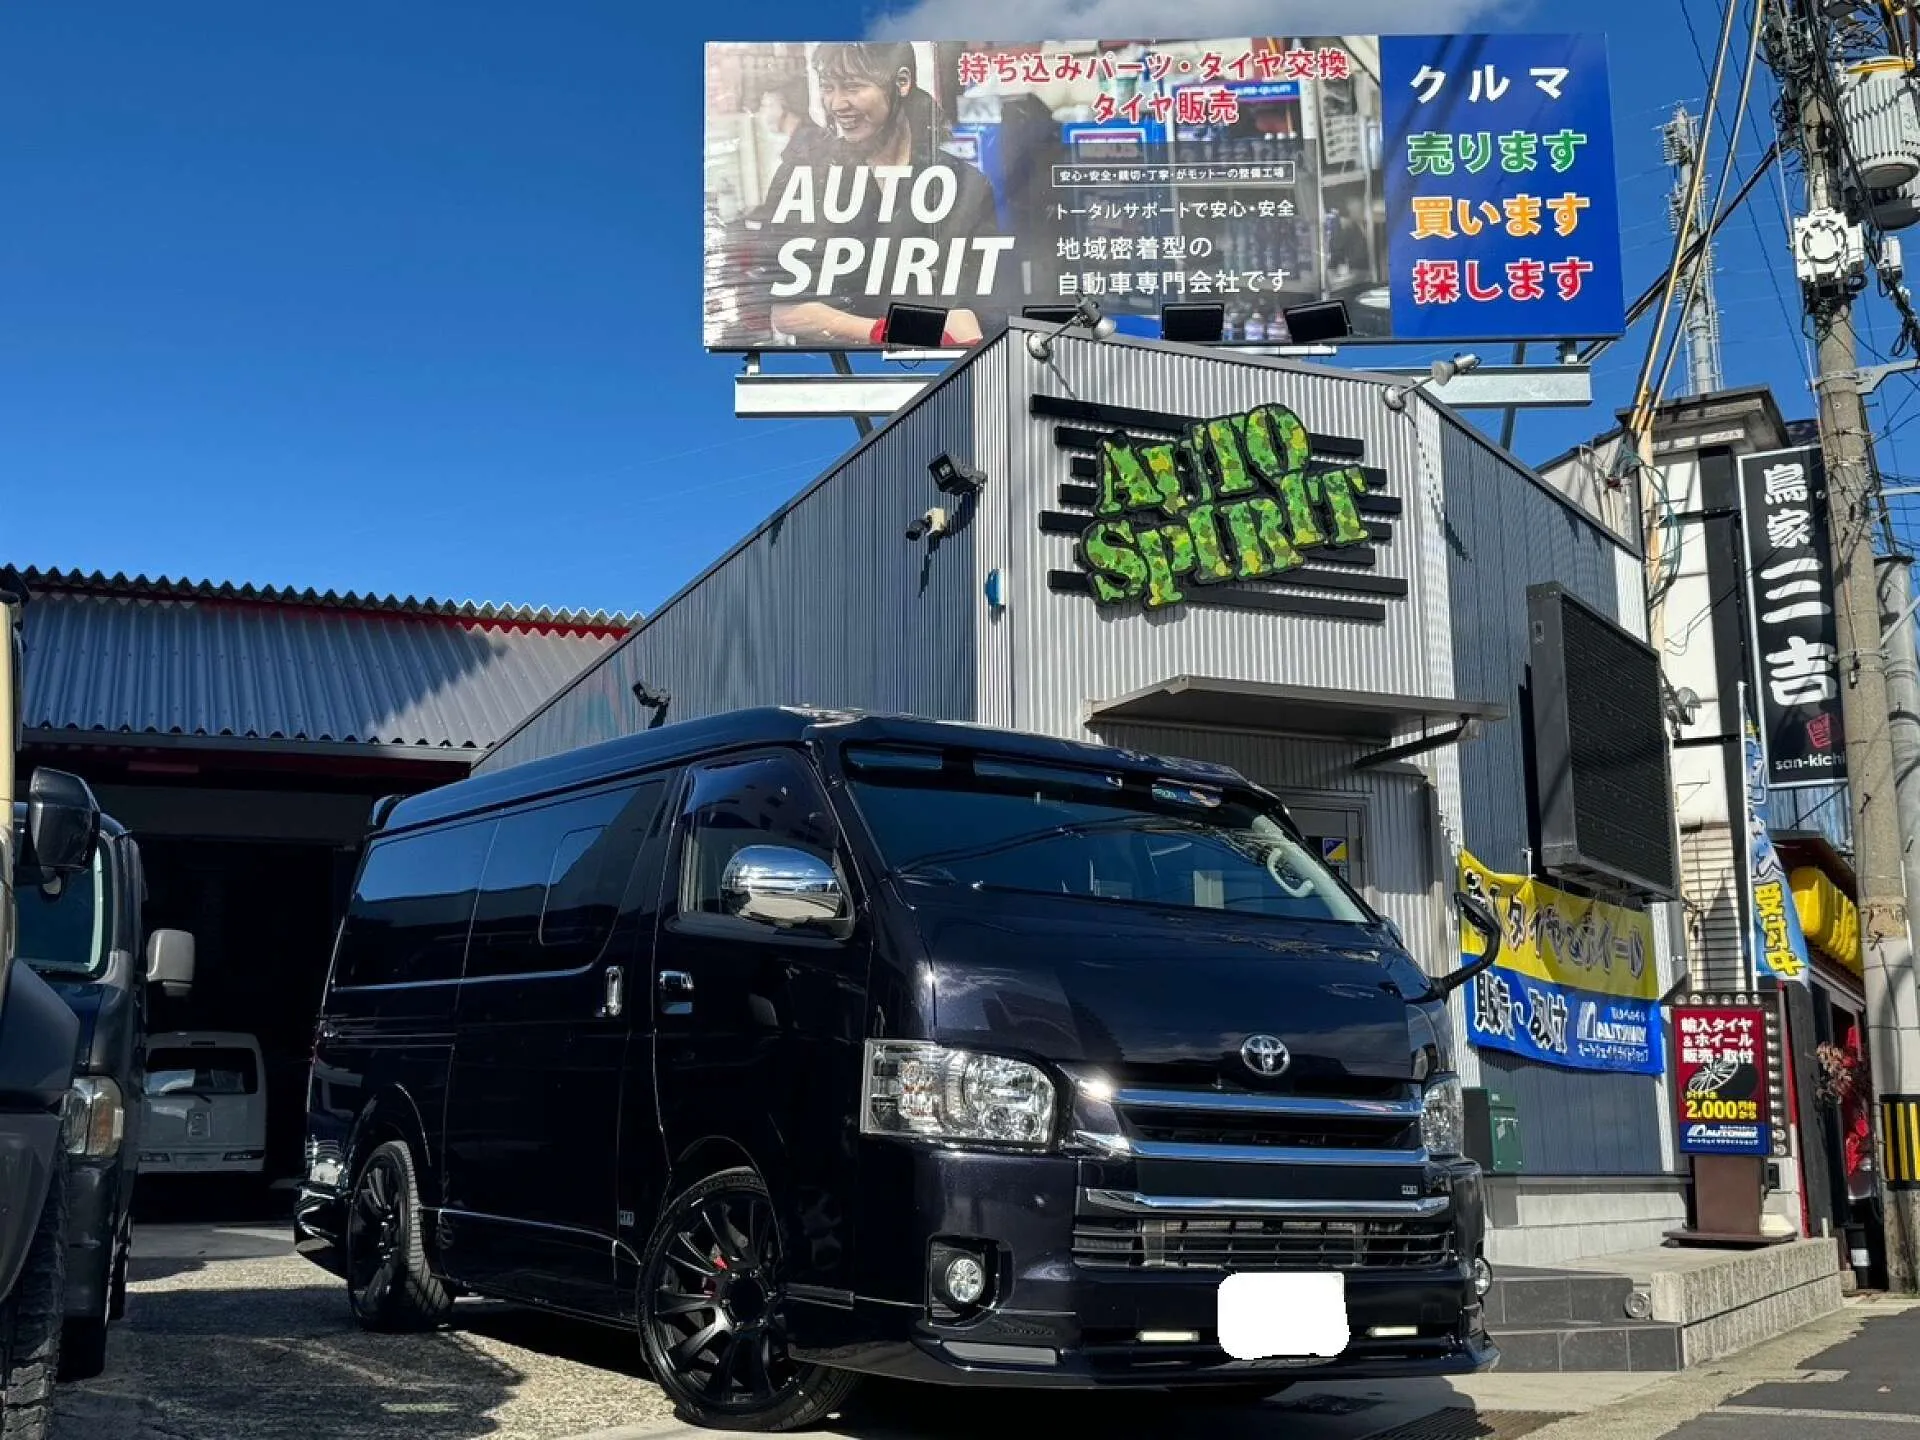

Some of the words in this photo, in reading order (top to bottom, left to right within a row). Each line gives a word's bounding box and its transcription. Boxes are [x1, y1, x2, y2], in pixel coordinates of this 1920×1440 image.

[957, 47, 1350, 84] 持ち込みパーツ・タイヤ交換
[1410, 65, 1569, 103] クルマ
[1092, 89, 1240, 124] タイヤ販売
[1407, 129, 1587, 176] 売ります
[771, 165, 957, 224] AUTO
[1057, 199, 1295, 220] トータルサポートで安心・安全
[1410, 192, 1590, 240] 買います
[770, 235, 1015, 297] SPIRIT
[1056, 235, 1213, 260] 地域密着型の
[1058, 268, 1291, 296] 自動車専門会社です
[1412, 256, 1593, 304] 探します
[1096, 402, 1312, 517] AUTO
[1081, 467, 1371, 611] SPIRIT
[1680, 1017, 1754, 1033] 輸入タイヤ
[1683, 1048, 1755, 1064] 販売・取付
